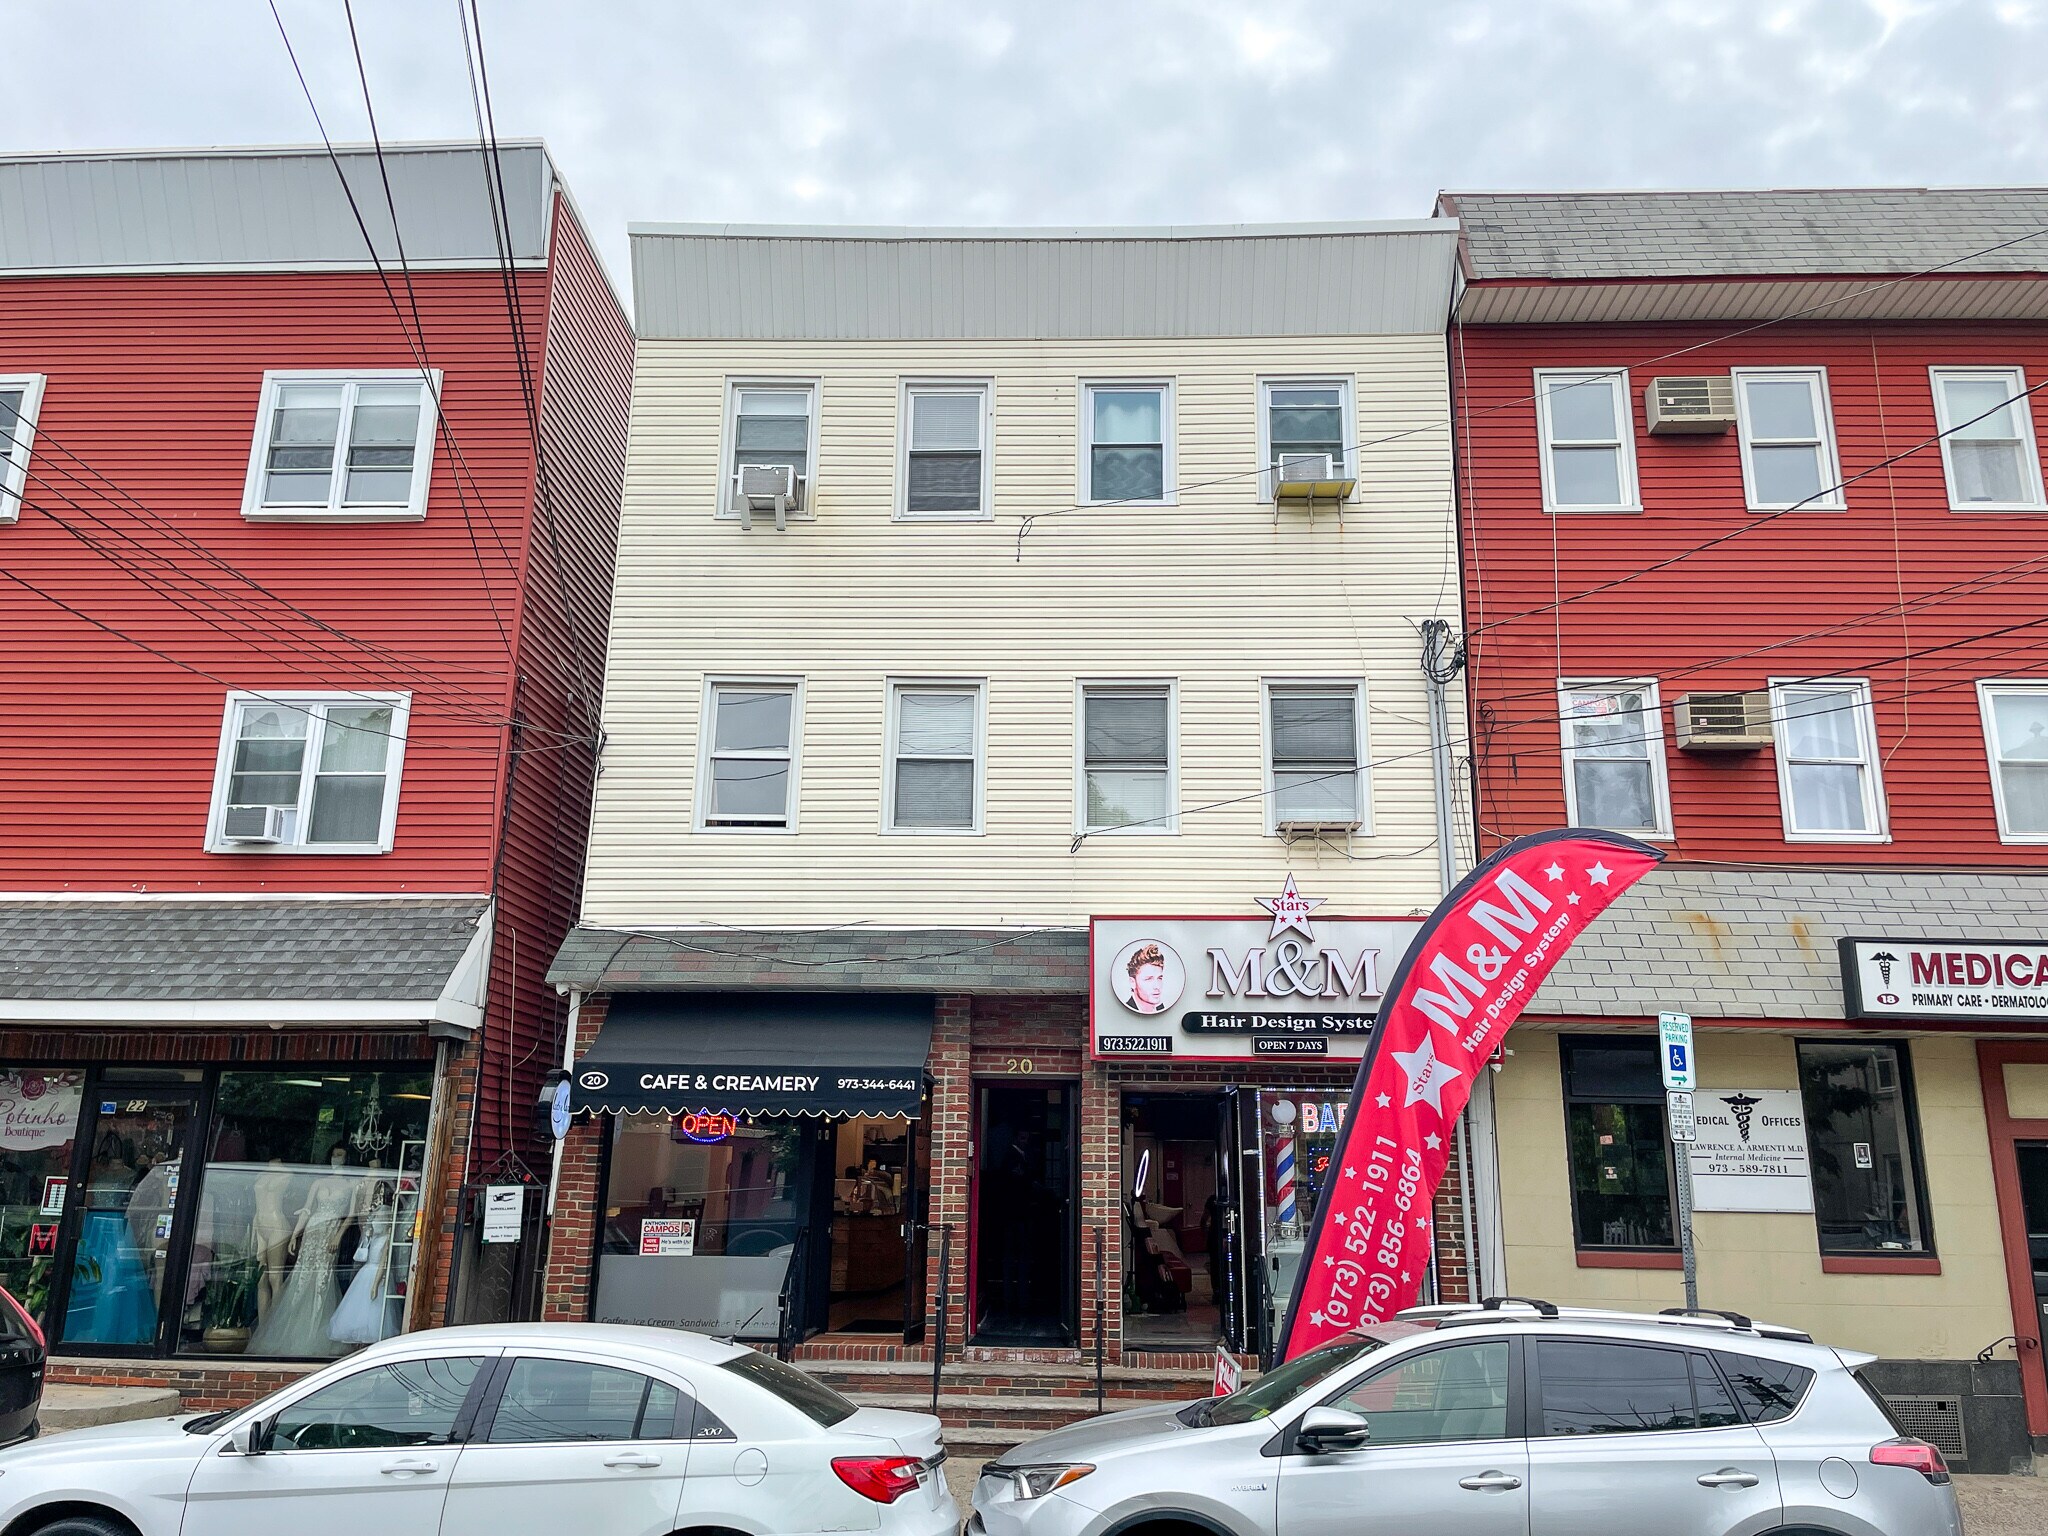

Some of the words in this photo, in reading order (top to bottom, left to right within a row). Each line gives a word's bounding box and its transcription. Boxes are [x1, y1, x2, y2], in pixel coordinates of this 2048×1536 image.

[1272, 898, 1310, 912] Stars
[1411, 867, 1553, 1037] M&M
[1206, 939, 1384, 998] M&M
[1908, 951, 2048, 989] MEDICA
[1461, 1017, 1492, 1053] Hair
[1485, 967, 1529, 1020] Design
[1524, 912, 1570, 968] System
[1880, 995, 1896, 1004] 18
[1912, 993, 1953, 1007] PRIMARY
[1957, 995, 1983, 1008] CARE
[1992, 995, 2048, 1009] DERMATOLO
[1200, 1014, 1247, 1029] Hair
[1251, 1014, 1317, 1033] Design
[1322, 1015, 1376, 1033] Syste
[1662, 1021, 1689, 1033] RESERVED
[1103, 1036, 1168, 1051] 973.522.1911
[1665, 1032, 1688, 1044] PARKING
[1258, 1040, 1287, 1050] OPEN
[1288, 1040, 1295, 1050] 7
[1296, 1040, 1323, 1050] DAYS
[1006, 1058, 1033, 1075] 20
[1412, 1052, 1436, 1095] Stars
[586, 1076, 601, 1085] 20
[639, 1074, 690, 1090] CAFE
[694, 1075, 708, 1090] &
[712, 1075, 820, 1092] CREAMERY
[837, 1078, 915, 1091] 973-344-6441
[128, 1100, 145, 1111] 22
[682, 1115, 737, 1136] OPEN
[1695, 1116, 1730, 1126] EDICAL
[1761, 1115, 1801, 1127] OFFICES
[4, 1126, 46, 1142] Boutique
[1689, 1143, 1735, 1151] LAWRENCE
[1746, 1144, 1785, 1152] ARMENTI
[1715, 1153, 1745, 1161] Internal
[1747, 1153, 1782, 1162] Medicine
[1708, 1164, 1729, 1173] 973
[1739, 1164, 1788, 1174] 589-7811
[643, 1225, 680, 1233] CAMPOS
[1323, 1259, 1367, 1328] (973)
[1345, 1135, 1398, 1256] 522-1911
[1356, 1272, 1398, 1328] 973)
[1377, 1147, 1422, 1269] 856-6864
[647, 1317, 675, 1327] Cream
[697, 1427, 723, 1437] 200
[1230, 1484, 1262, 1492] HYBRID
